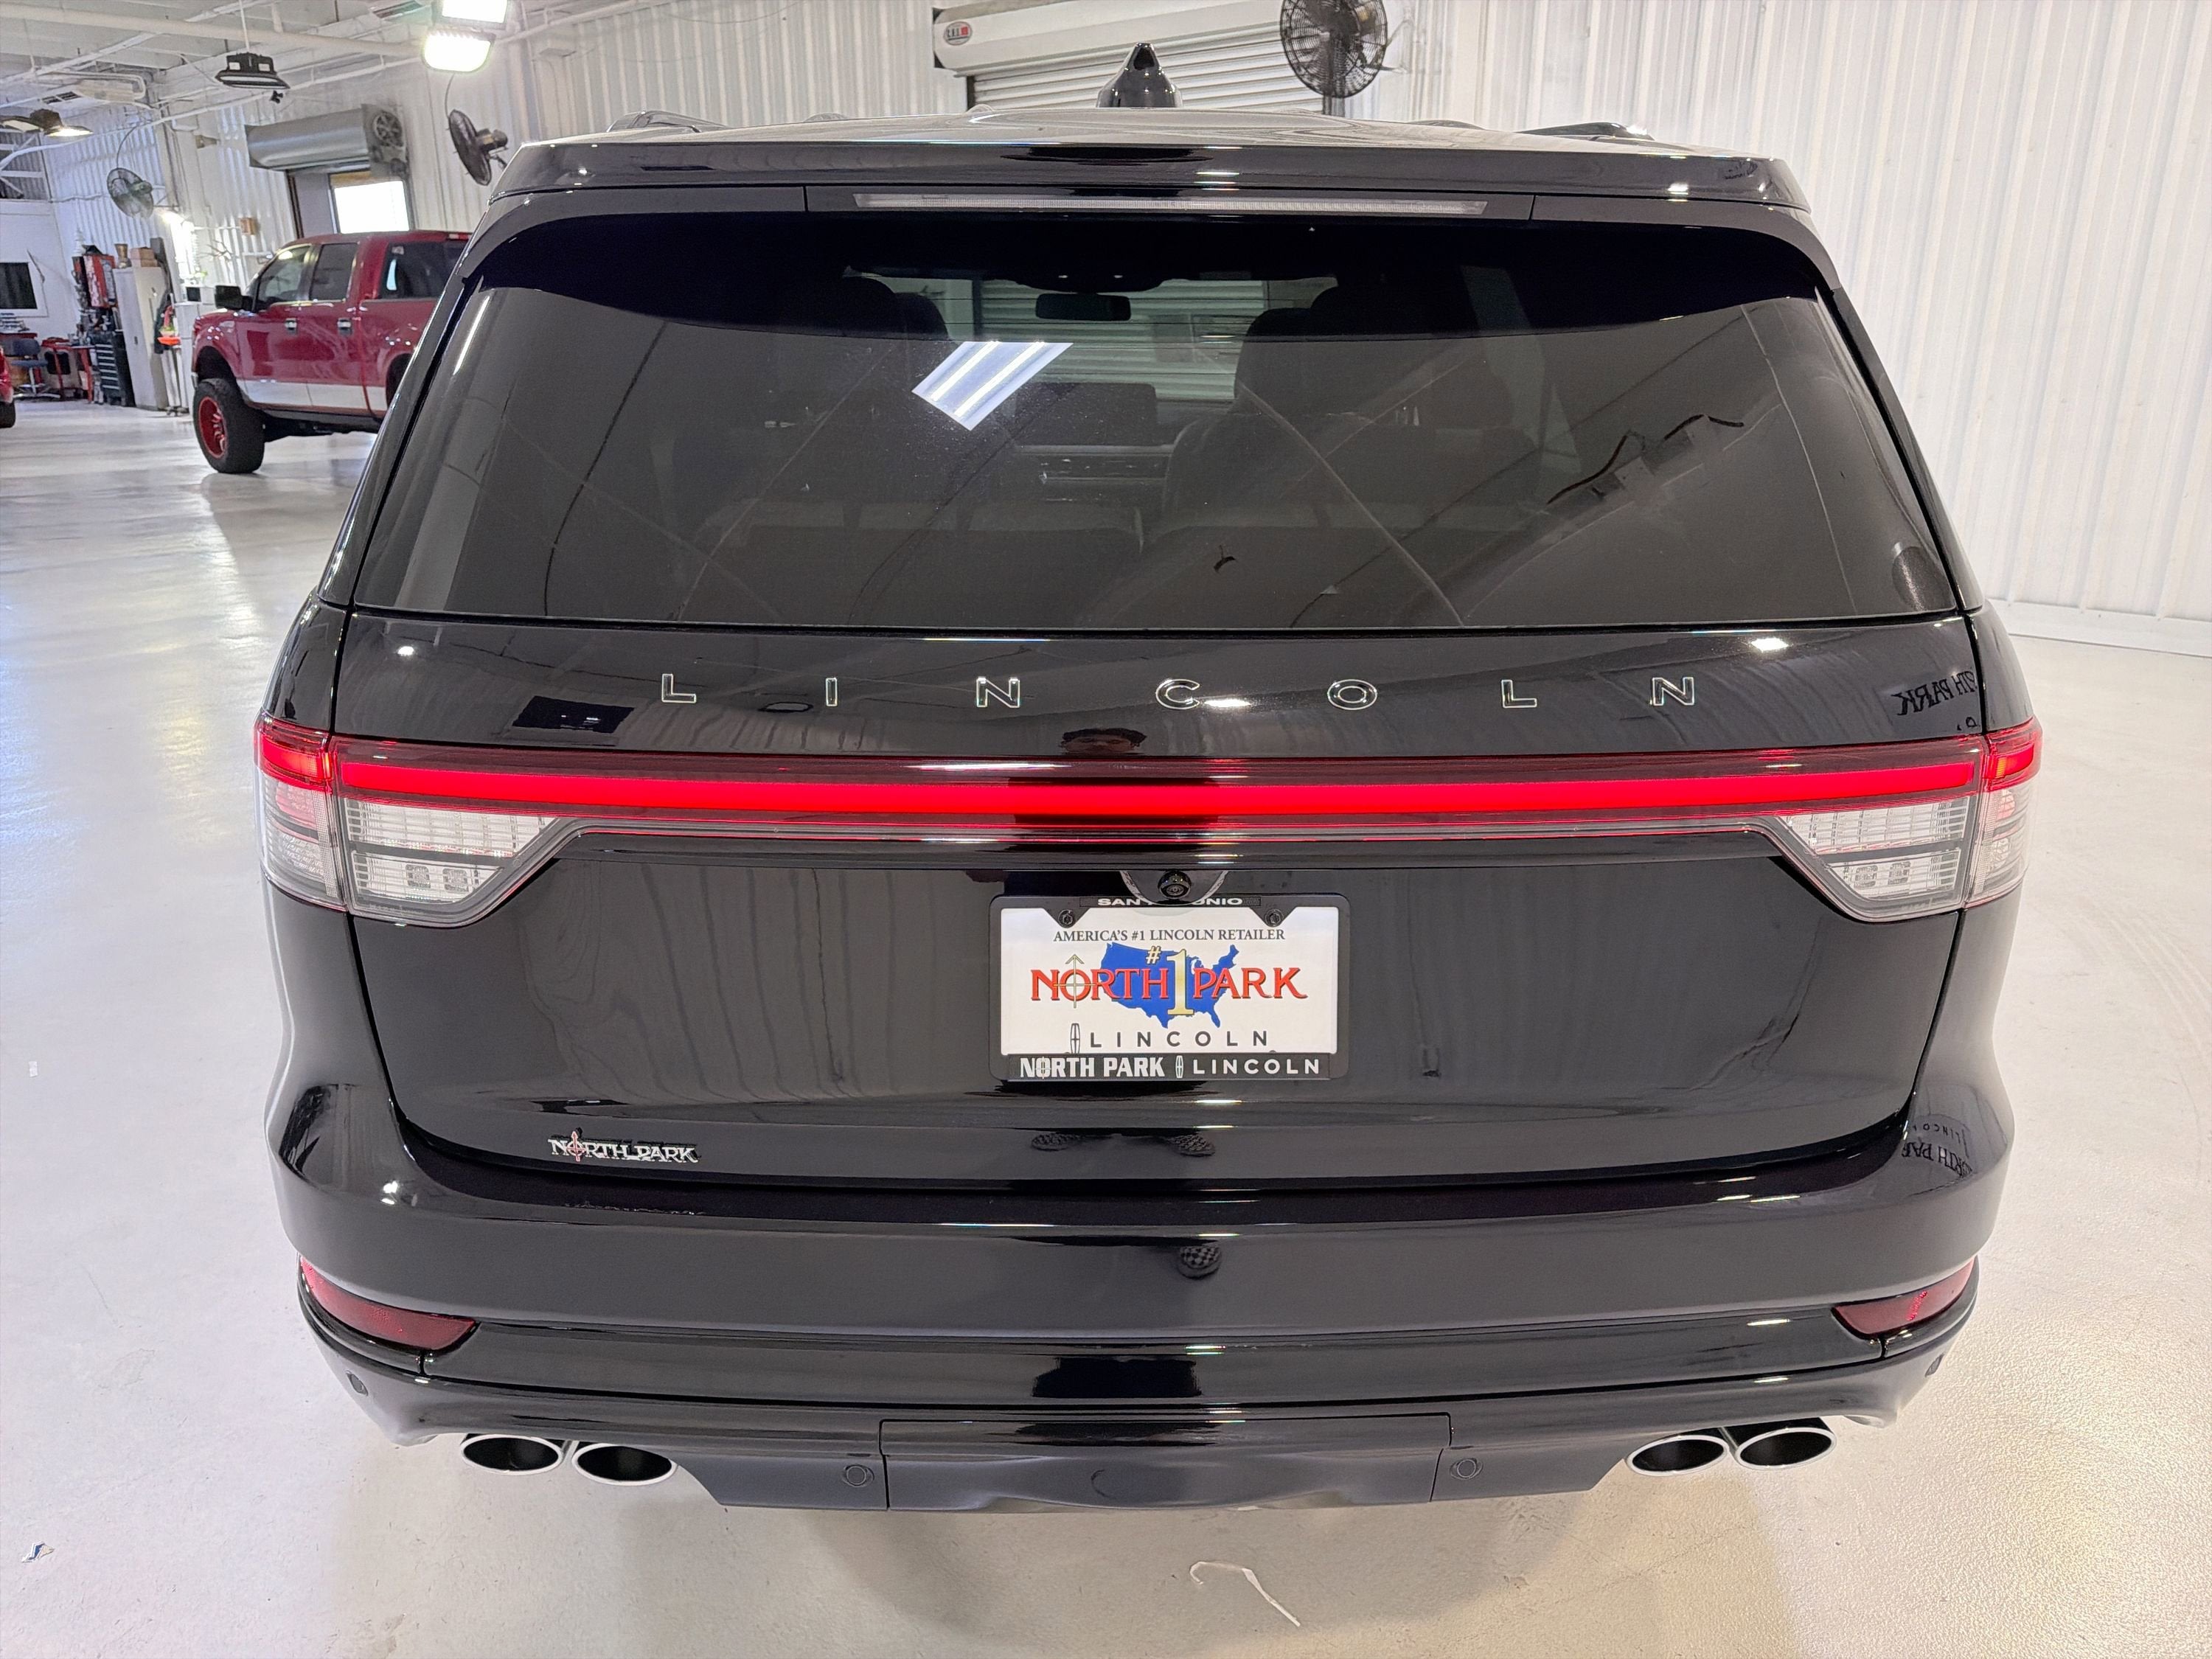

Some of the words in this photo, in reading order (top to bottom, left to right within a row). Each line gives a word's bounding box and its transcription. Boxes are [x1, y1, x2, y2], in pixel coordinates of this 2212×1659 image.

[661, 673, 1695, 711] LINCOLN
[1053, 930, 1128, 942] AMERICA'S
[1131, 930, 1146, 942] #1
[1150, 929, 1214, 941] LINCOLN
[1218, 929, 1285, 940] RETAILER
[1030, 967, 1169, 1001] NORTH
[1193, 967, 1308, 999] PARK
[1090, 1030, 1267, 1048] LINCOLN
[1020, 1057, 1095, 1079] NORTH
[1103, 1057, 1165, 1077] PARK
[1192, 1059, 1320, 1074] LINCOLN
[548, 1138, 628, 1161] NORTH
[633, 1144, 698, 1163] PARK
